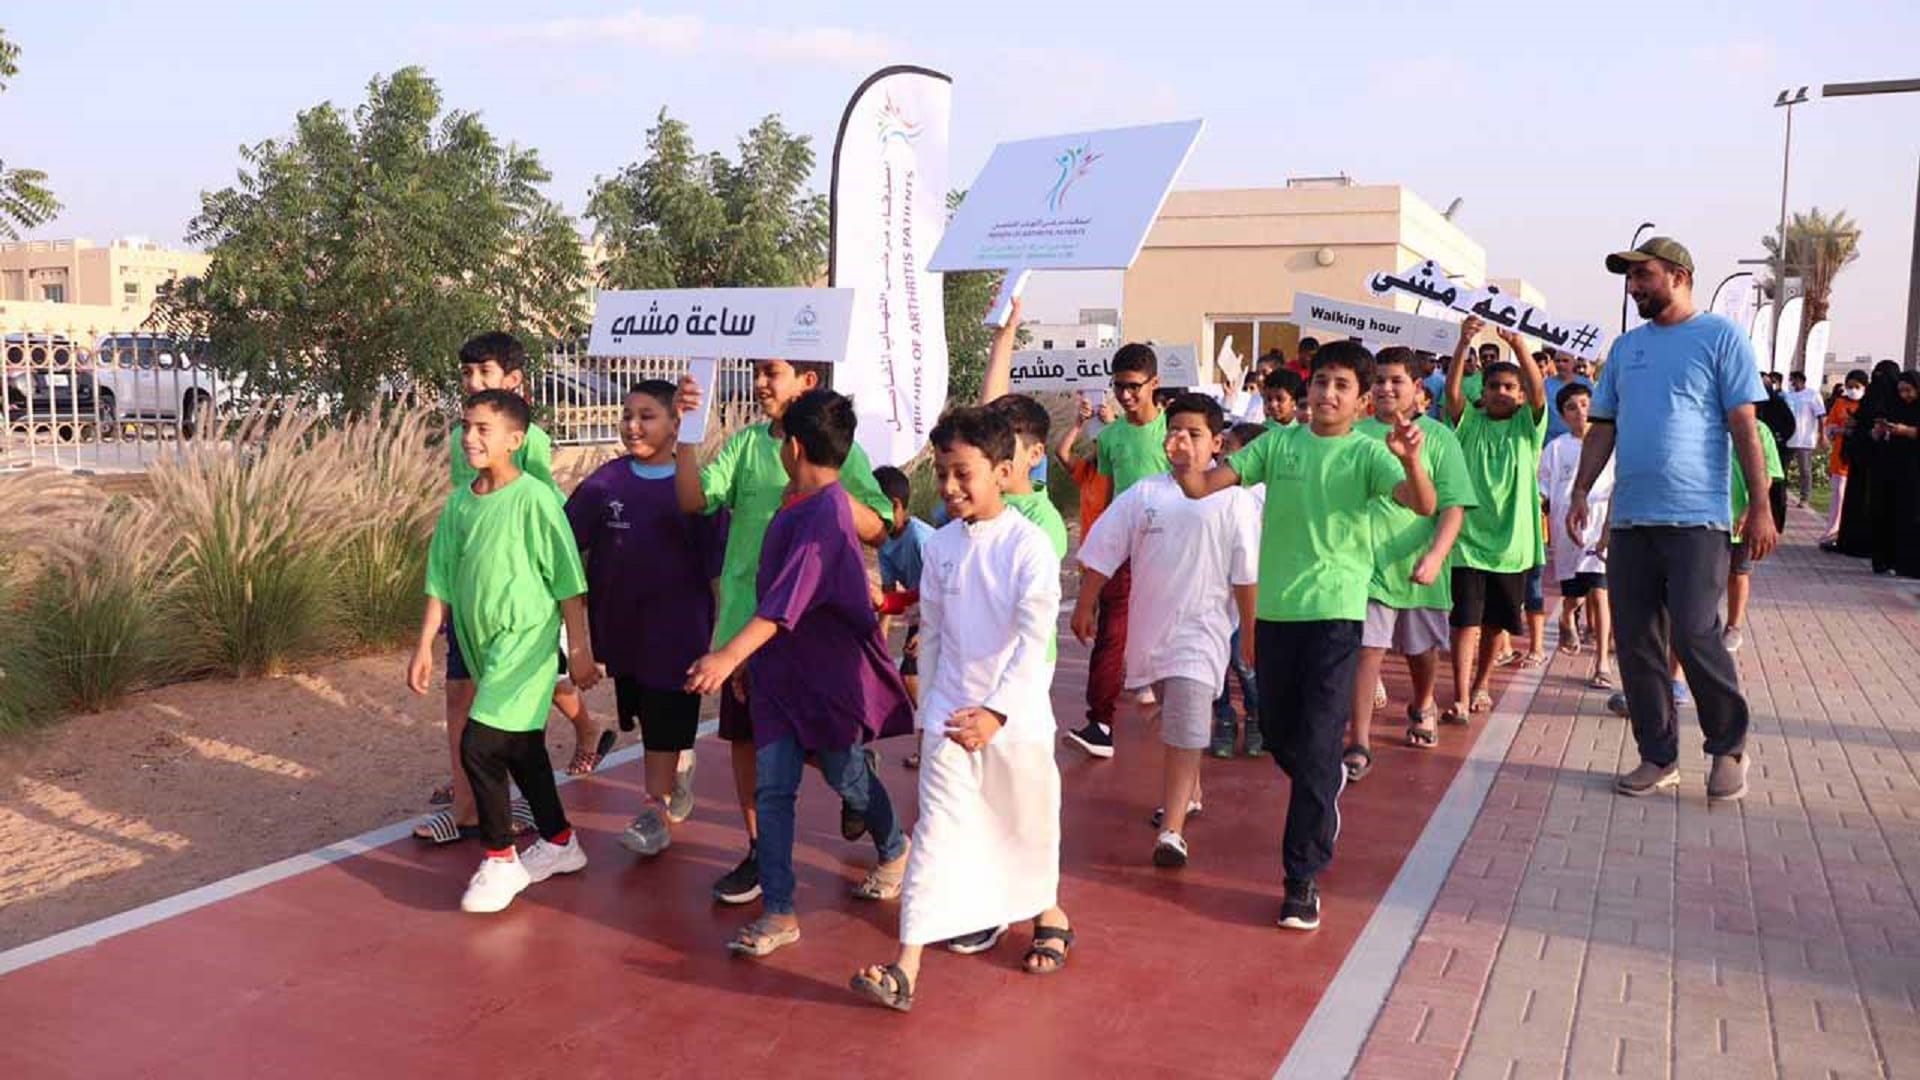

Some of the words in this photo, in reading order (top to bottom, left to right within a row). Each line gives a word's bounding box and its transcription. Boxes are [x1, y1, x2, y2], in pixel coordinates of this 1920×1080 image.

[902, 251, 921, 335] ARTHRITIS
[610, 300, 679, 343] مشي
[686, 305, 756, 336] ساعة
[1310, 305, 1366, 330] Walking
[1369, 317, 1402, 335] hour
[911, 338, 922, 361] OF
[1009, 355, 1114, 385] اعة_مشي
